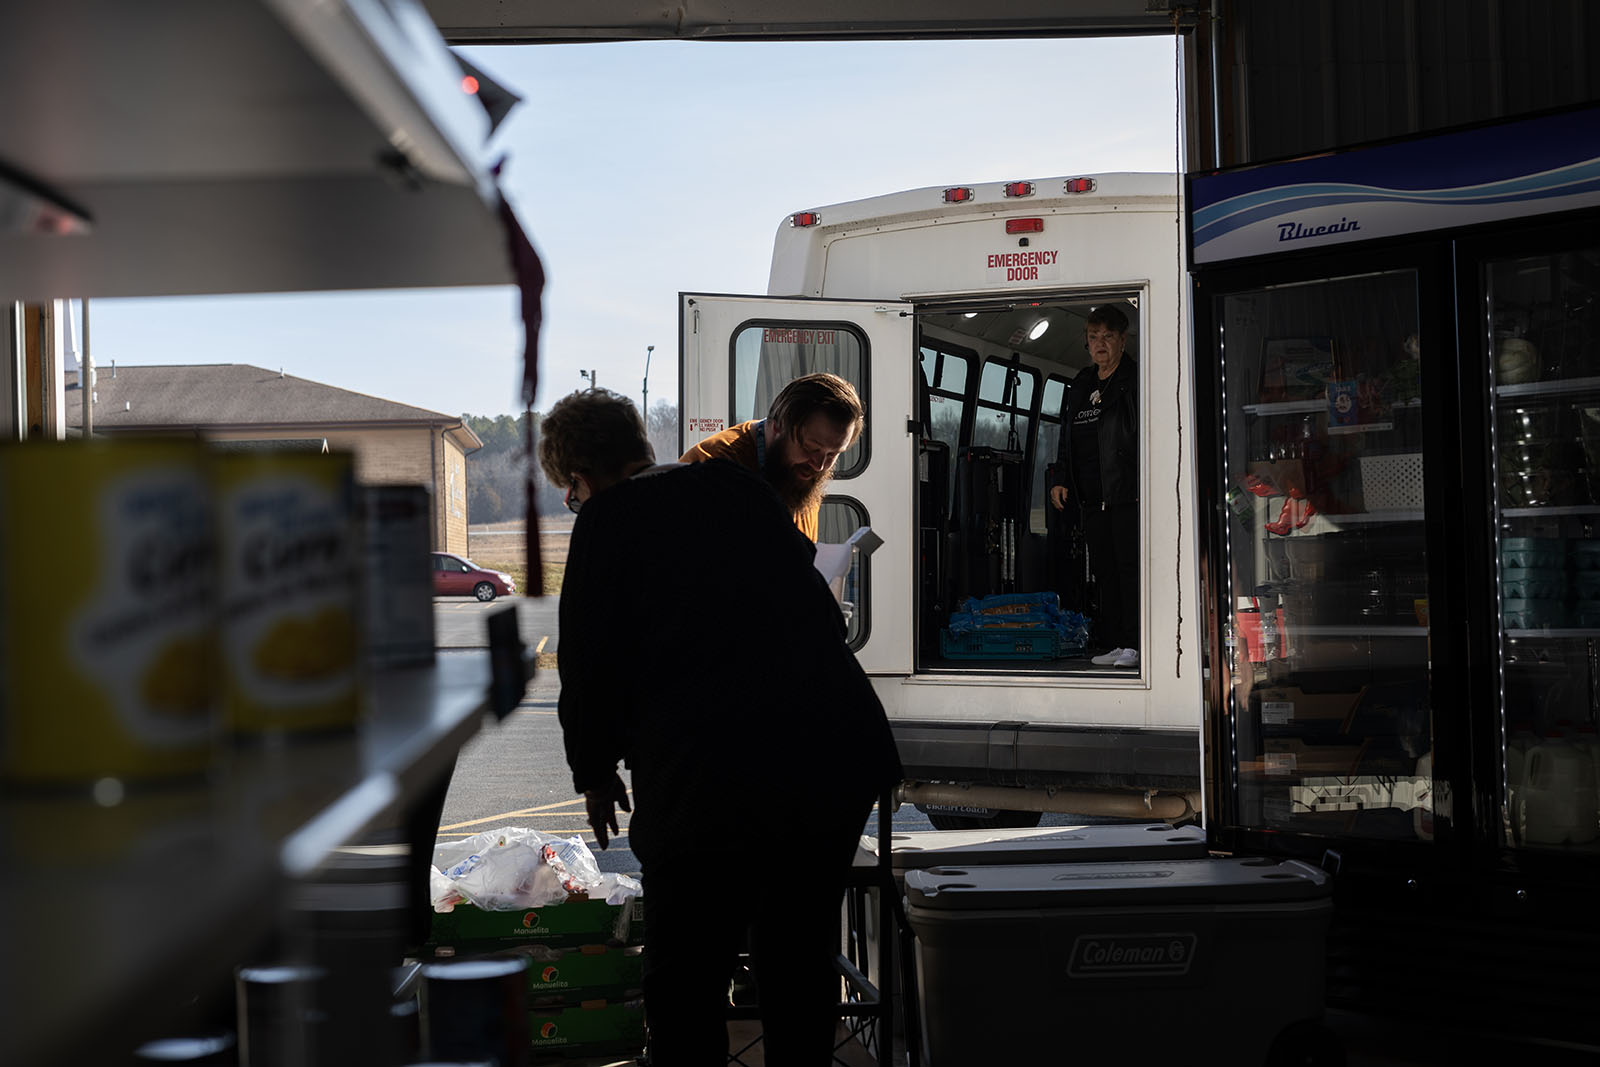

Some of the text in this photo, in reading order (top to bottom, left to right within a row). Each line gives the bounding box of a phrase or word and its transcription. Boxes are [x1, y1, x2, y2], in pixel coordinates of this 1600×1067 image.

[1277, 217, 1361, 242] Blueair
[987, 250, 1058, 268] EMERGENCY
[1007, 266, 1038, 281] DOOR
[763, 329, 835, 345] EMERGENCY EXIT
[513, 927, 550, 935] Manuelita
[1082, 940, 1165, 964] Coleman
[532, 980, 569, 990] Manuelita
[531, 1036, 568, 1047] Manuelita
